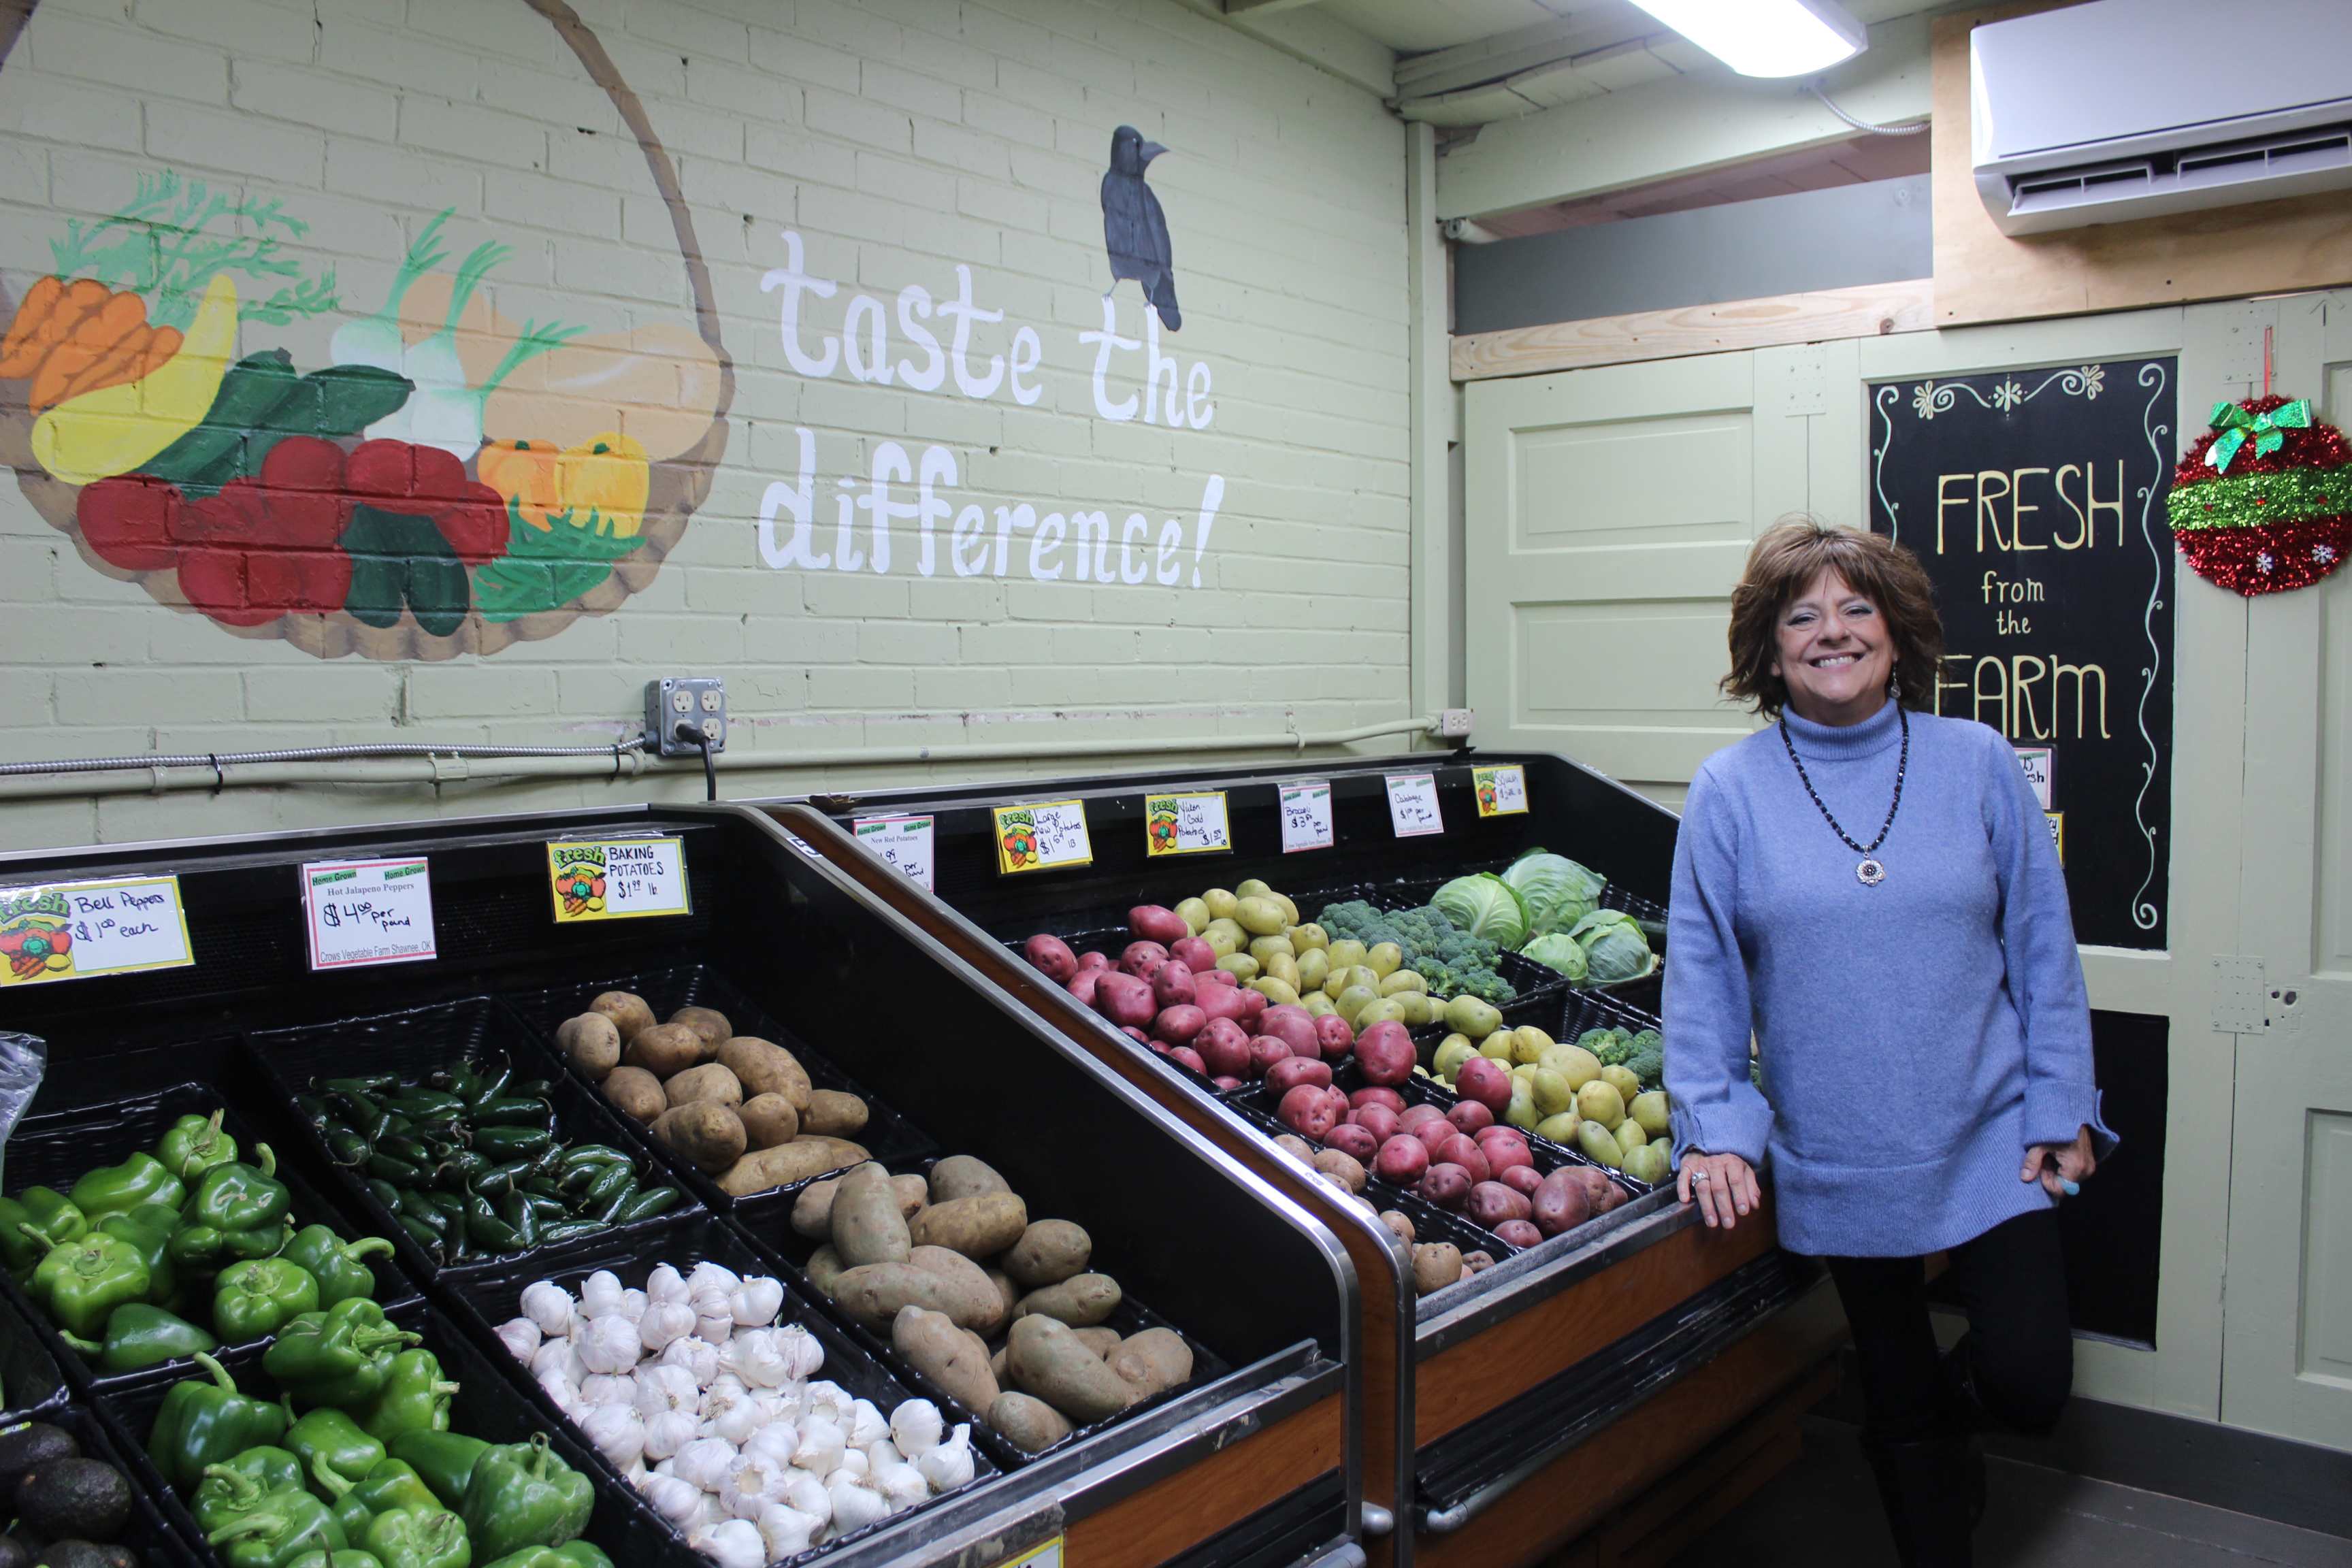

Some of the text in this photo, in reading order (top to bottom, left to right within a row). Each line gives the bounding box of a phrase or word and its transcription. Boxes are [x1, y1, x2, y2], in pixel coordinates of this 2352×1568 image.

[760, 230, 1213, 430] taste the
[757, 426, 1225, 588] difference!
[1936, 459, 2124, 555] FRESH
[1981, 570, 2045, 604] from
[1996, 609, 2032, 635] the
[1149, 798, 1178, 816] fresh
[998, 809, 1034, 830] fresh
[1034, 808, 1061, 826] Large
[1187, 812, 1203, 824] Gold
[553, 845, 606, 870] fresh
[608, 845, 654, 861] BAKING
[312, 870, 357, 886] Home Grown
[385, 865, 426, 881] Home Grown
[609, 862, 664, 877] POTATOES
[327, 882, 414, 896] Hot Jalapeno Peppers
[75, 892, 165, 913] Bell Peppers
[371, 909, 395, 924] per
[120, 922, 159, 938] each
[321, 940, 432, 962] Crows Vegetable Farm Shawnee, OK
